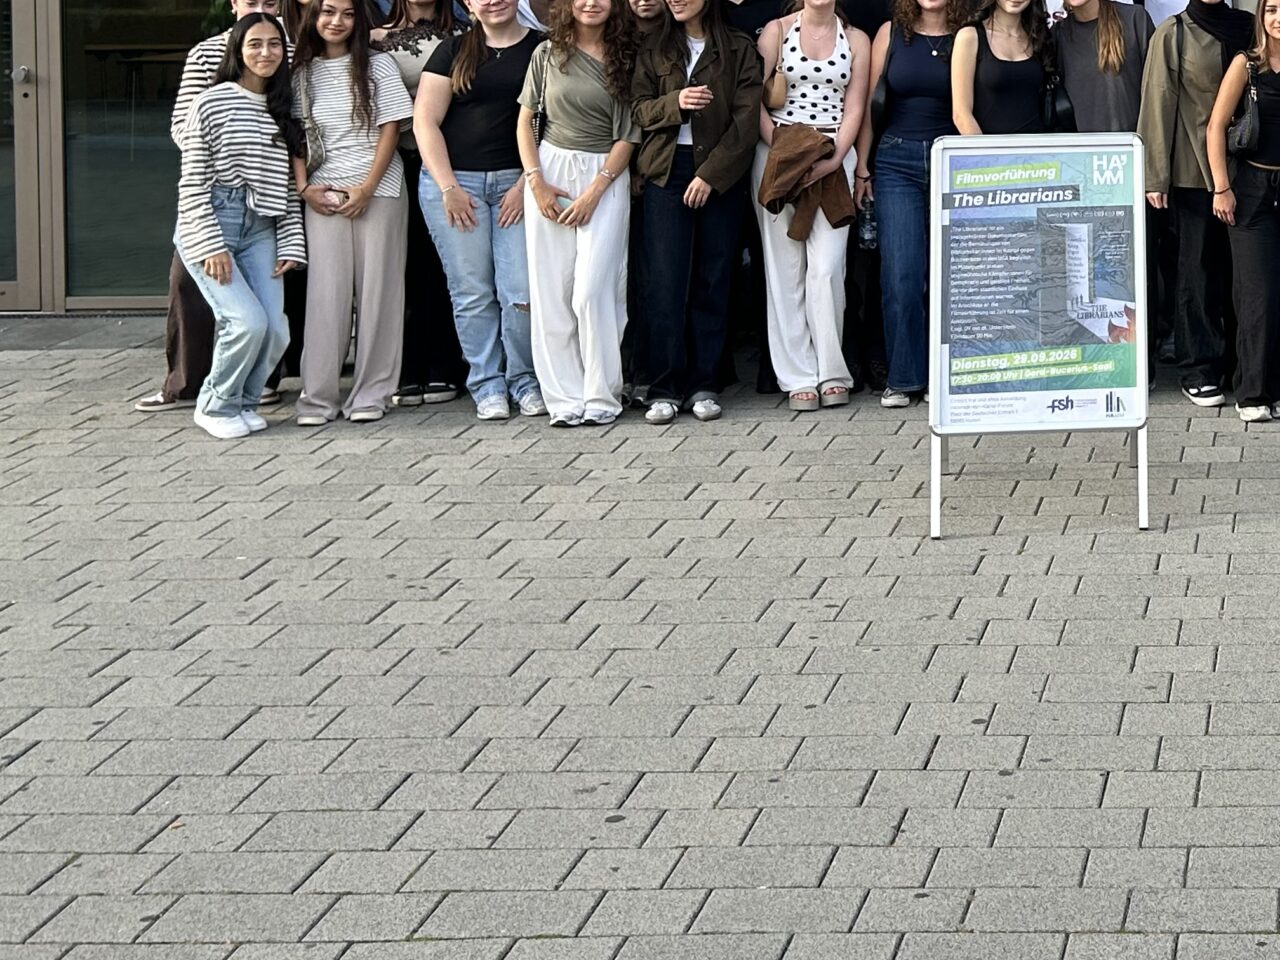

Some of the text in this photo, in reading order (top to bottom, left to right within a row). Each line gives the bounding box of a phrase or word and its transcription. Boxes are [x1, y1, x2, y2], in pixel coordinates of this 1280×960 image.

[956, 168, 1056, 184] Filmvorführung
[1093, 170, 1124, 184] MM
[953, 188, 1072, 208] The Librarians
[1076, 310, 1124, 320] LIBRARIANS
[952, 358, 1010, 370] Dienstag,
